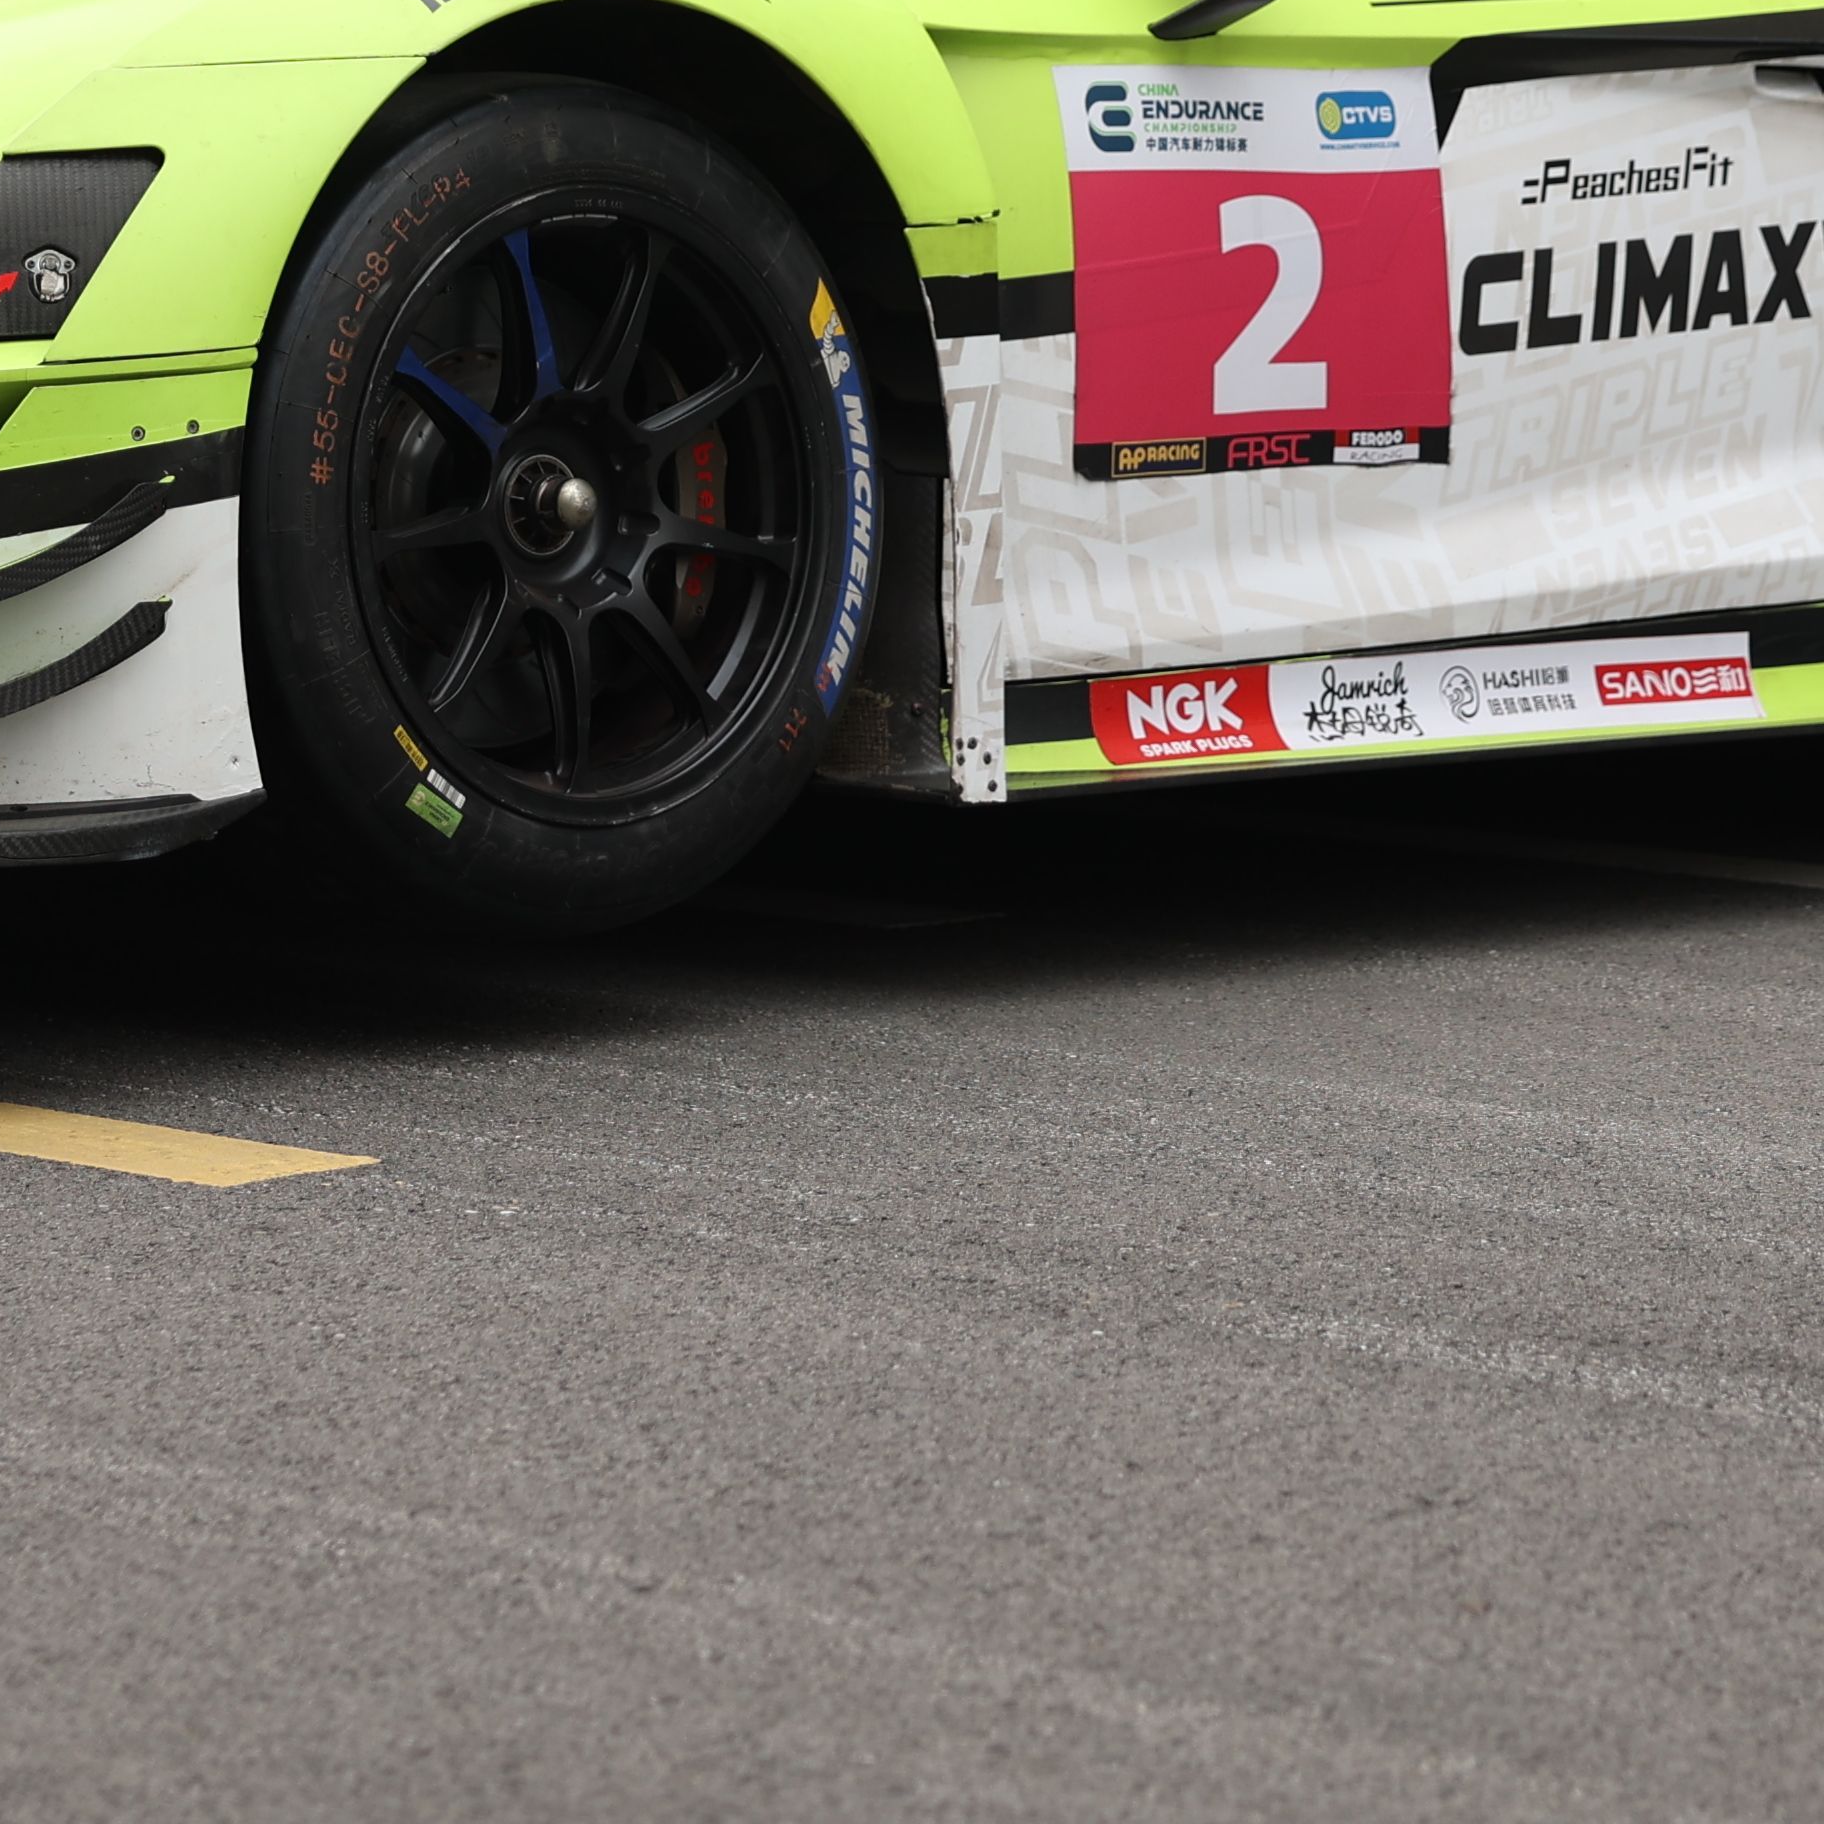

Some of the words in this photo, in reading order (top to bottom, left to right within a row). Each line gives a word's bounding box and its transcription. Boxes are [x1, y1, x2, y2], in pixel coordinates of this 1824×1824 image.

[1137, 83, 1180, 97] CHINA
[1141, 100, 1264, 121] ENDURANCE
[1342, 105, 1393, 125] CTVS
[1144, 122, 1238, 133] CHAMPIONSHIP
[1146, 137, 1248, 153] 中国汽车耐力锦标赛
[1213, 194, 1328, 415] 2
[1351, 429, 1404, 447] FERODO
[1119, 446, 1145, 471] AP
[1147, 443, 1200, 461] RACING
[1349, 448, 1405, 461] RACING
[813, 392, 877, 688] MICHELIN
[1320, 661, 1409, 714] Jamrich
[1126, 676, 1243, 740] NGK
[1140, 740, 1196, 758] SPARK
[1198, 734, 1254, 752] PLUGS
